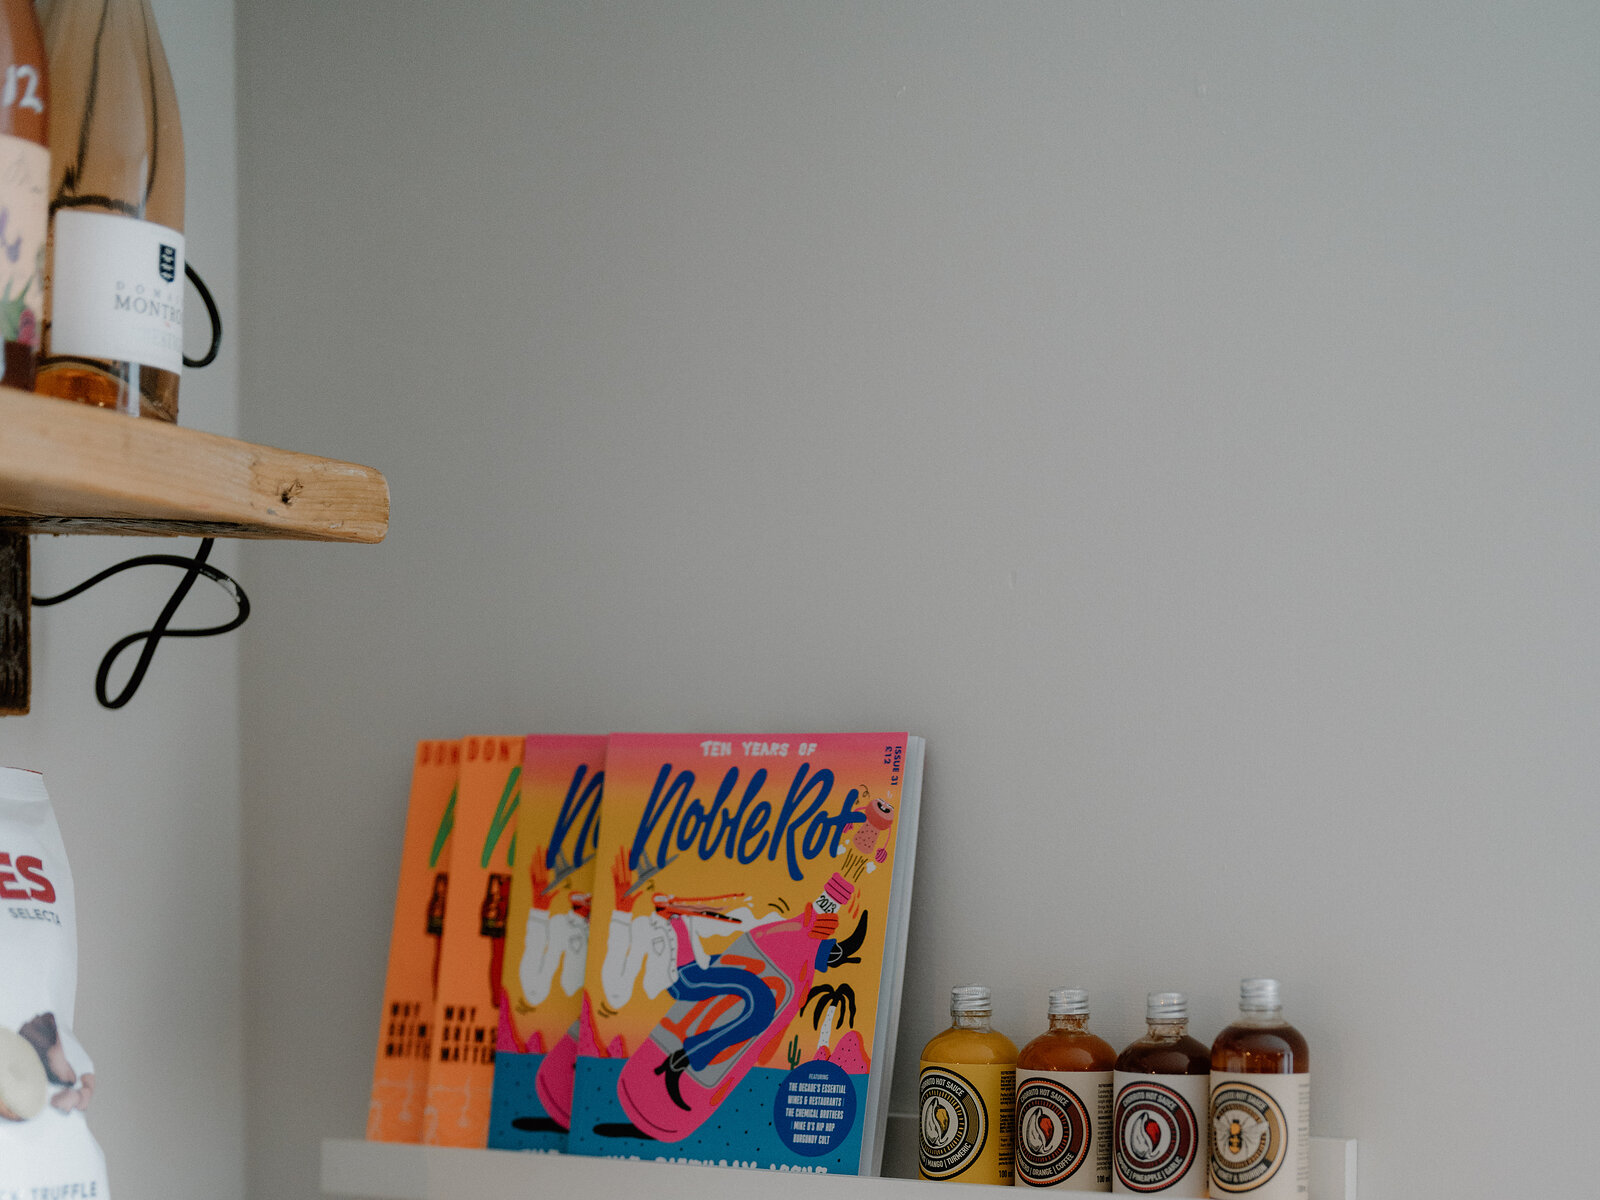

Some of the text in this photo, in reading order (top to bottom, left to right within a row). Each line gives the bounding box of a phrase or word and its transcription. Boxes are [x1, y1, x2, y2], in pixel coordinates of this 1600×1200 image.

[700, 740, 817, 757] TEN YEARS OF
[884, 745, 893, 765] £12
[893, 745, 902, 772] ISSUE
[815, 895, 837, 914] 2013
[788, 1082, 846, 1094] THE DECADE'S ESSENTIAL
[945, 1080, 965, 1098] SAUCE
[1039, 1088, 1050, 1097] HOT
[1050, 1091, 1070, 1106] SAUCE
[787, 1095, 803, 1105] WINES
[809, 1097, 842, 1107] RESTAURANTS
[1157, 1094, 1178, 1111] SAUCE
[785, 1107, 844, 1120] THE CHEMICAL BROTHERS
[793, 1121, 806, 1131] MIKE
[816, 1123, 824, 1132] HIP
[825, 1123, 835, 1132] HOP
[793, 1134, 830, 1145] BURGUNDY CULT
[927, 1142, 972, 1168] MANGO TURMERIC
[1032, 1167, 1053, 1176] ORANGE
[1056, 1152, 1075, 1171] COFFEE
[1132, 1171, 1162, 1182] PINEAPPLE
[1165, 1156, 1183, 1175] GARLIC
